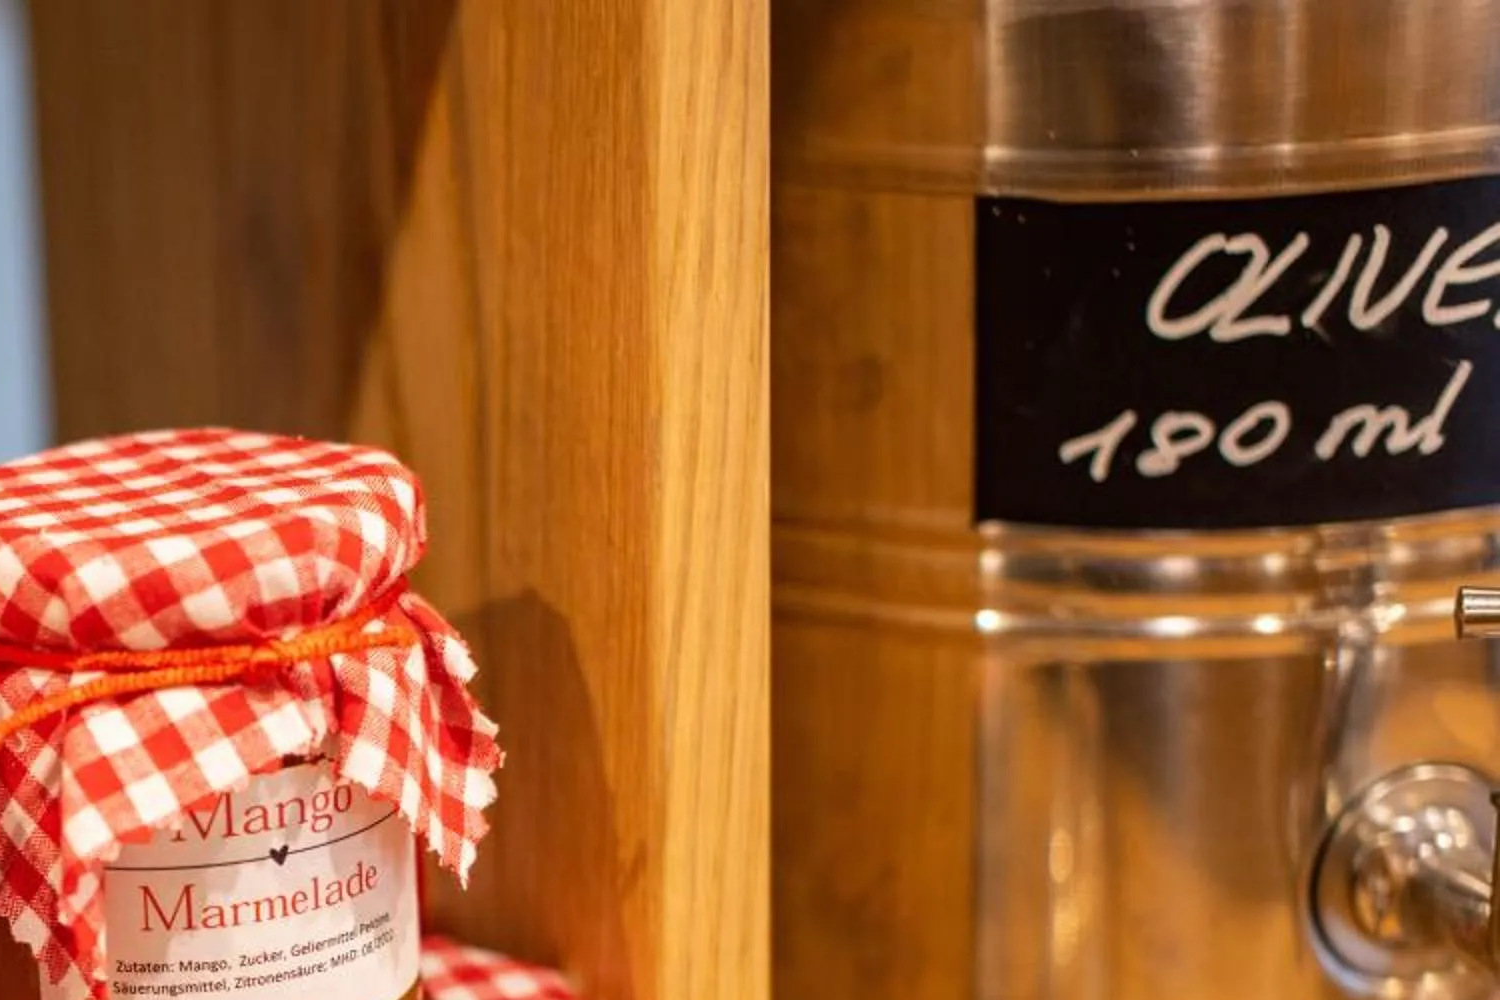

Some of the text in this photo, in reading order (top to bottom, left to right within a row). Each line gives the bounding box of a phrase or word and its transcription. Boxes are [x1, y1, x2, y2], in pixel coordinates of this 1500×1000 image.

[1146, 222, 1500, 341] OLIVE
[1059, 359, 1473, 482] 180 ml
[138, 860, 378, 932] Marmelade
[116, 959, 174, 974] Zutaten:
[179, 959, 232, 973] Mango,
